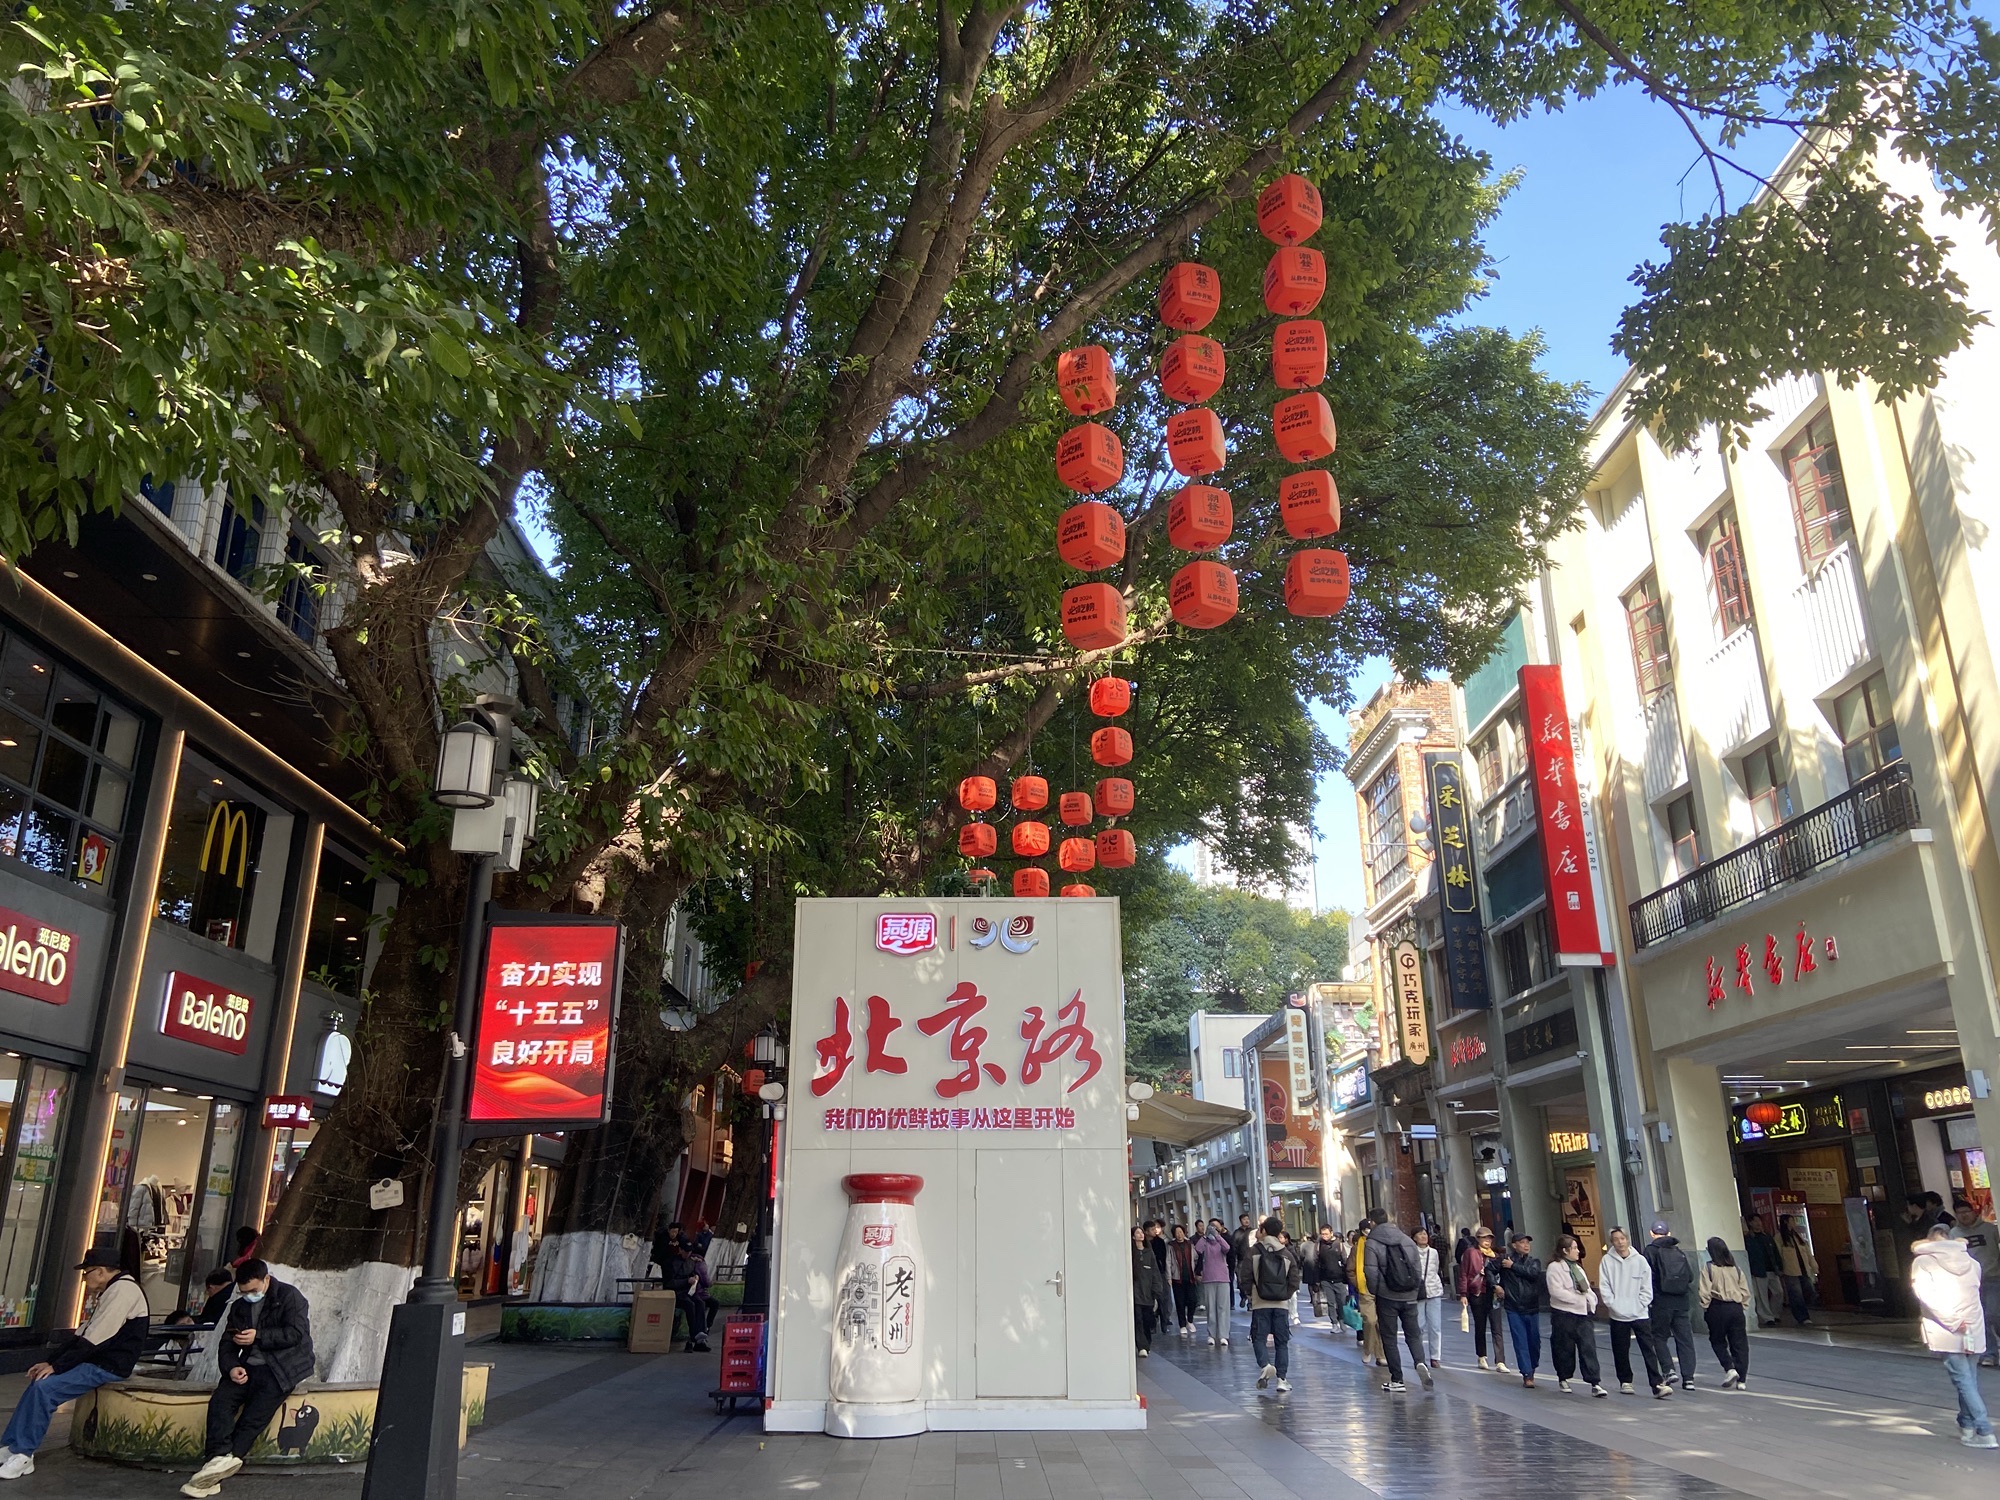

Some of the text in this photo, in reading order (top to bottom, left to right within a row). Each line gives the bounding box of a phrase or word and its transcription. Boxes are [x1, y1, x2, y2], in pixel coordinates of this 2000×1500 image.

[1438, 784, 1471, 888] 采芝林
[1578, 783, 1590, 817] BOOK
[1585, 831, 1598, 872] STORE
[0, 925, 67, 986] leno
[38, 926, 71, 953] 班尼路
[883, 918, 932, 944] 燕塘
[500, 961, 603, 987] 奋力实现
[179, 990, 247, 1041] Baleno
[226, 993, 249, 1014] 班尼路
[1403, 974, 1421, 1037] 巧克玩家
[490, 1039, 595, 1066] 良好开局
[810, 981, 1103, 1099] 北京路
[825, 1108, 1076, 1131] 我们的优鲜故事从这里开始
[885, 1266, 914, 1341] 老广州
